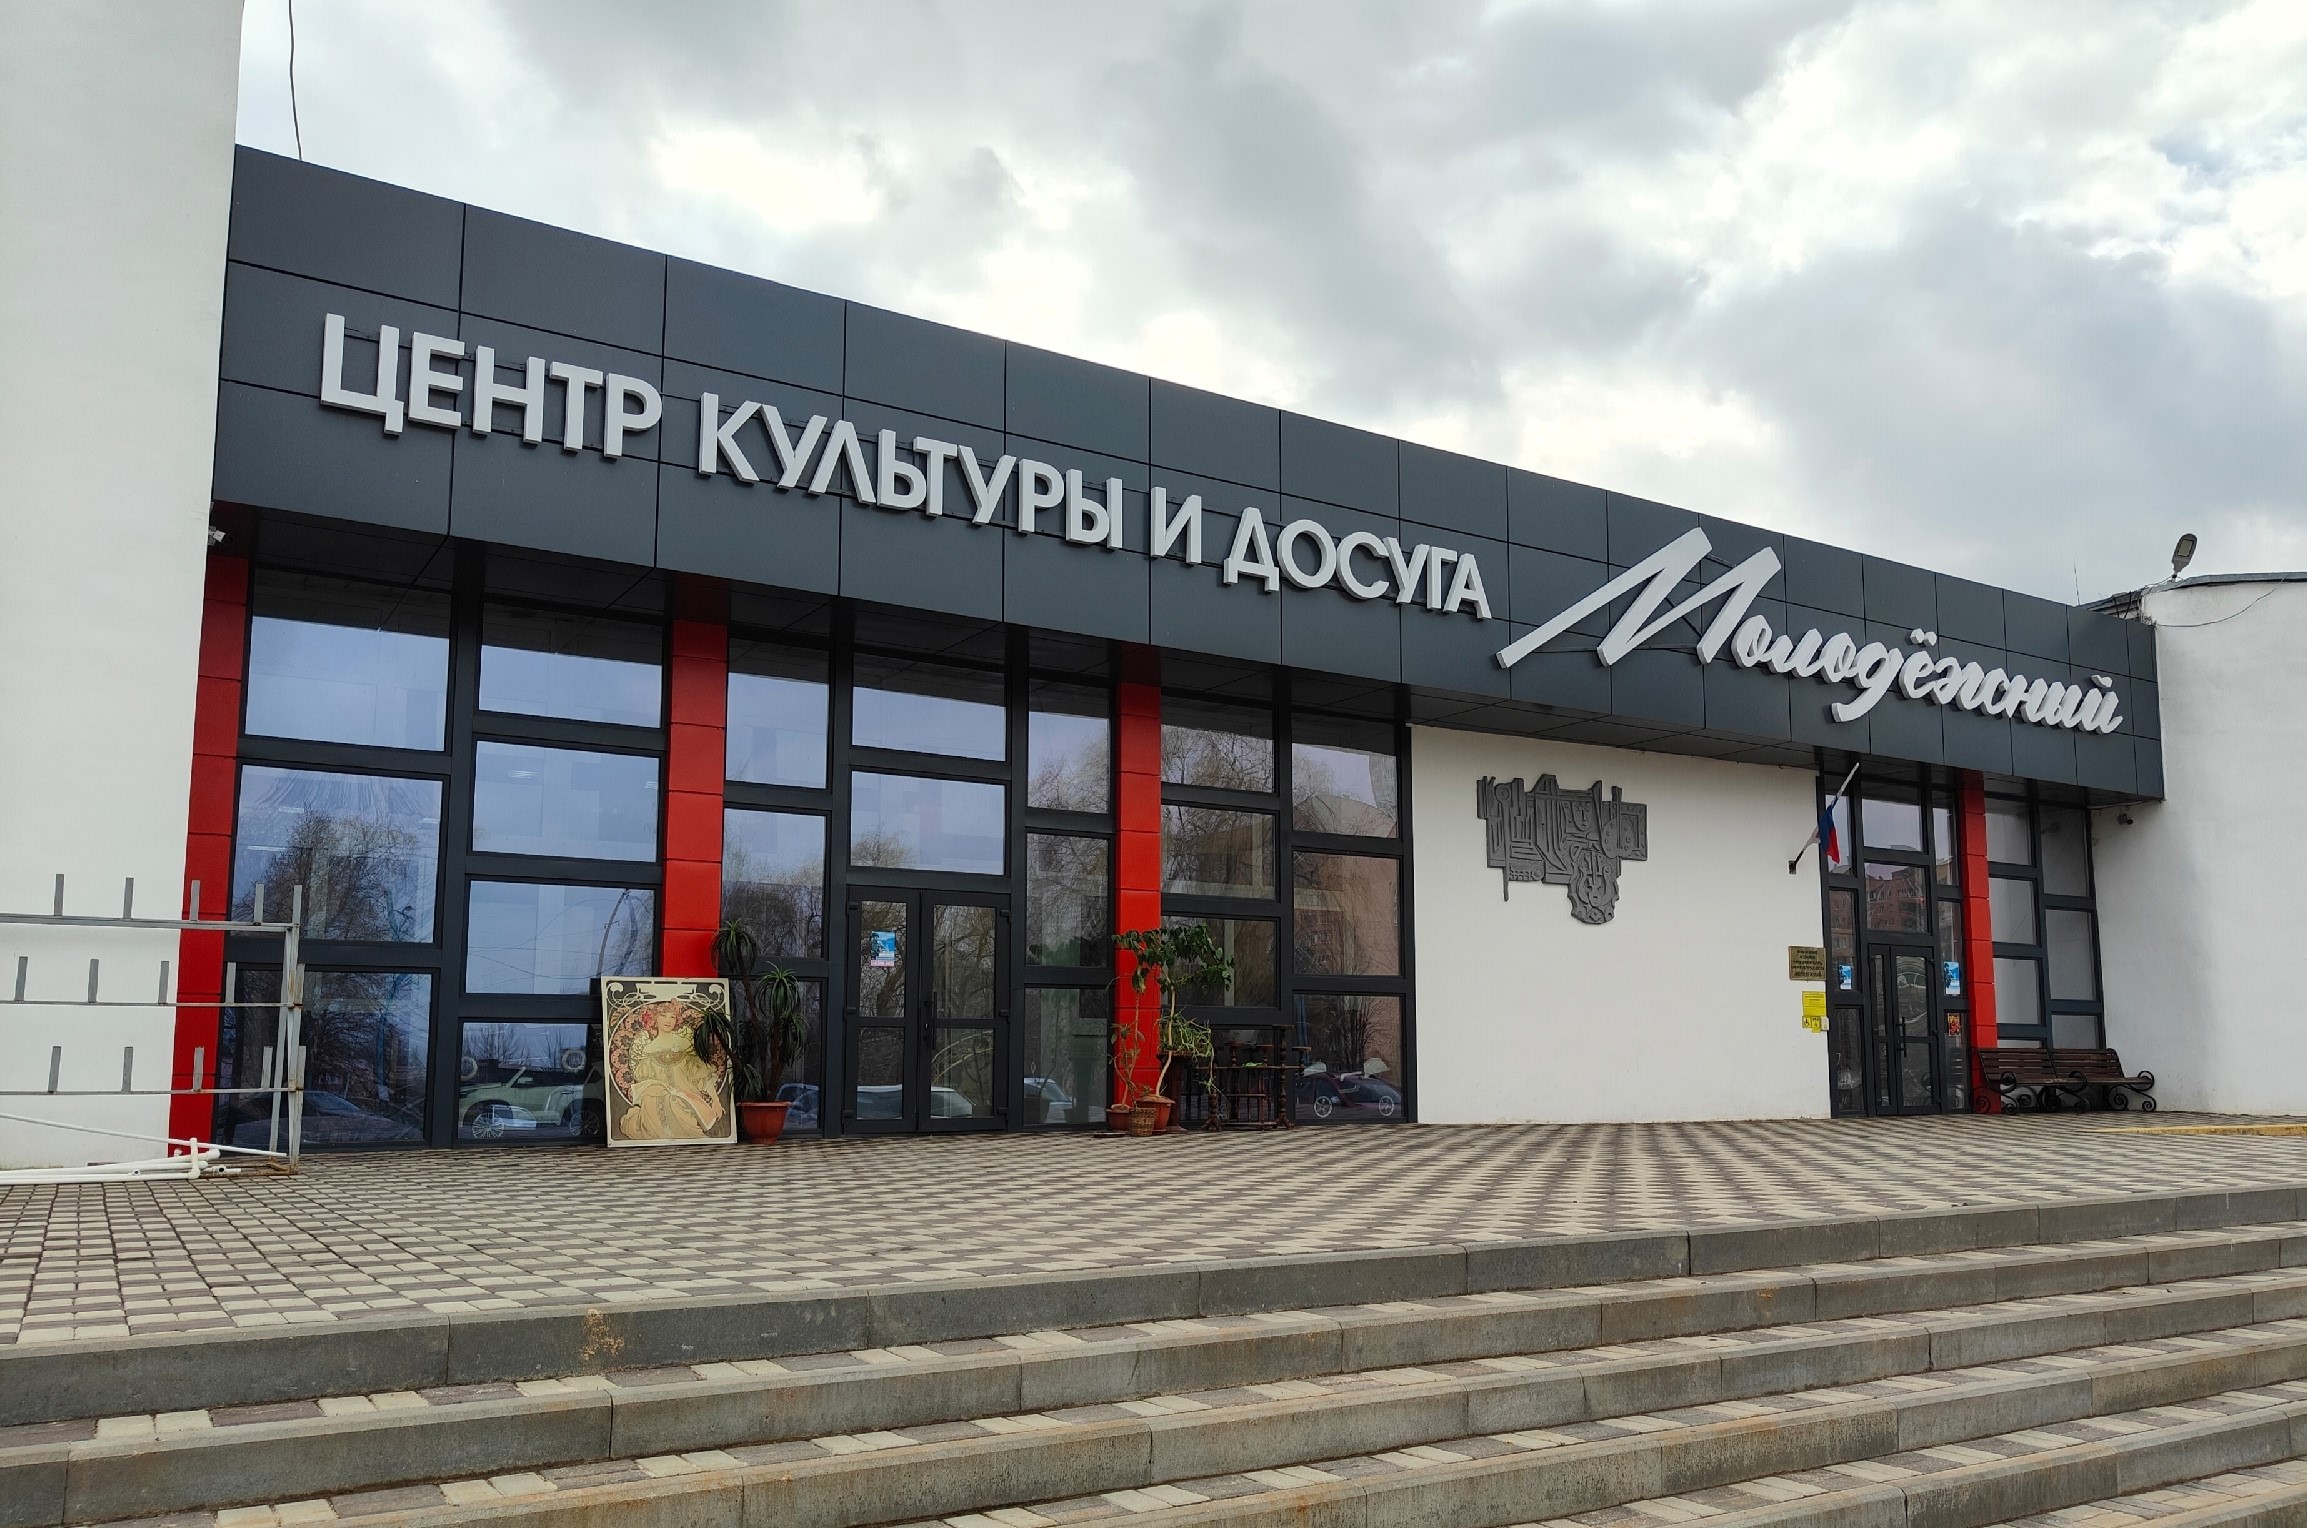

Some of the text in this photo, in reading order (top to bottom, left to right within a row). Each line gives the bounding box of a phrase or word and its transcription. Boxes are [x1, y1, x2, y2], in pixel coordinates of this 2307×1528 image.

[321, 313, 1492, 619] ЦЕНТР КУЛЬТУРЫ И ДОСУГА
[1496, 527, 2123, 735] Молодёжный
